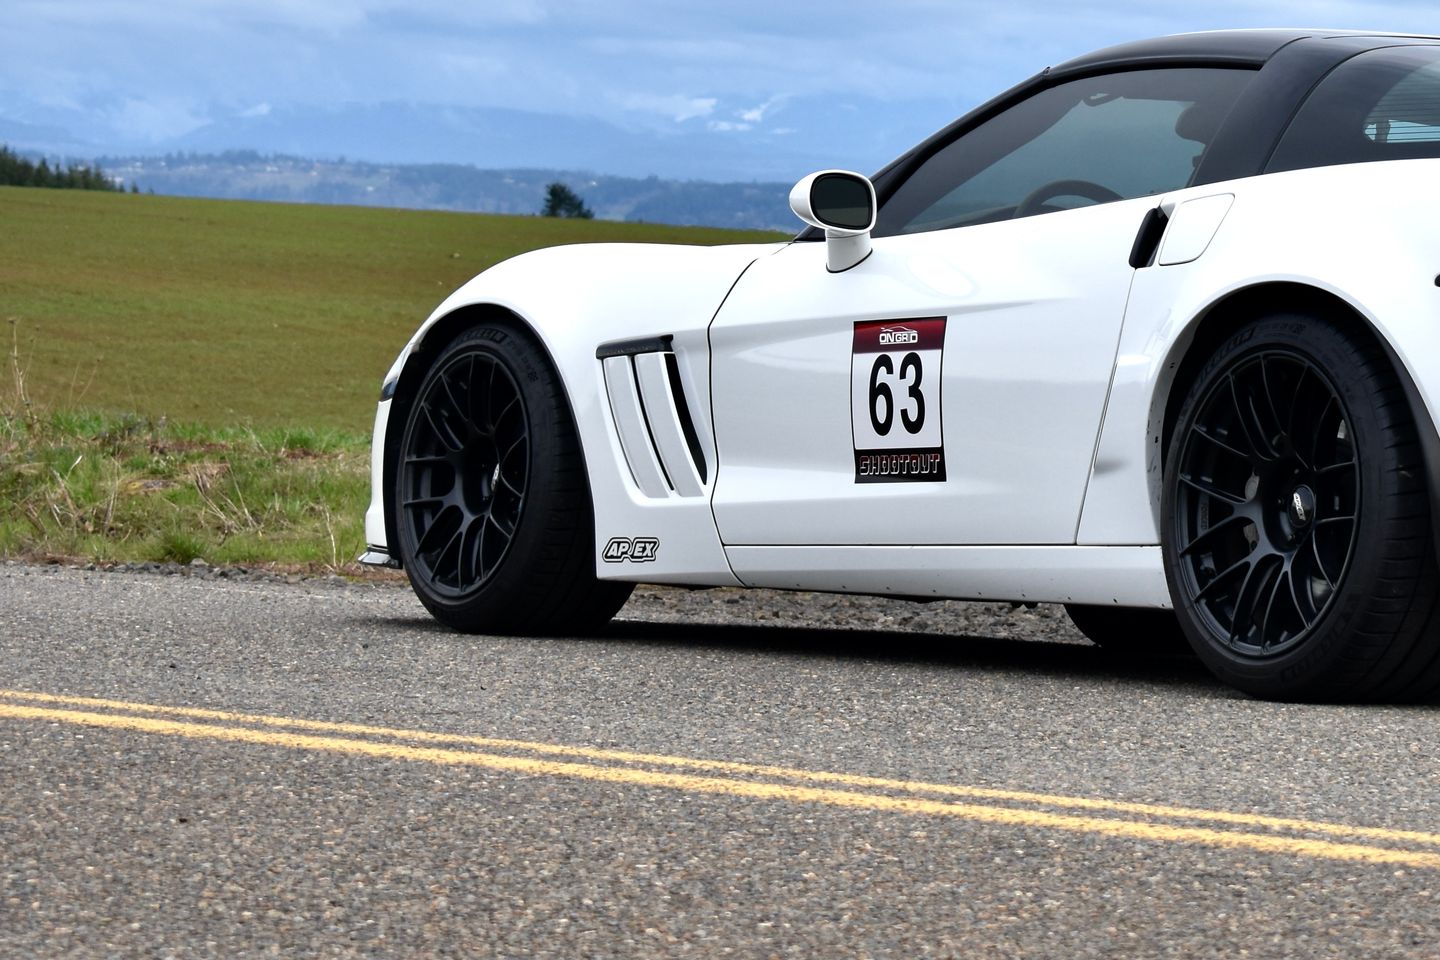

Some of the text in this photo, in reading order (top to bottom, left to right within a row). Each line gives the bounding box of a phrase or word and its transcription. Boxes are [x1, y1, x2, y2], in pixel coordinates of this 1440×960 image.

[869, 352, 925, 436] 63
[860, 454, 940, 475] SHOOTOUT
[606, 541, 655, 558] APEX
